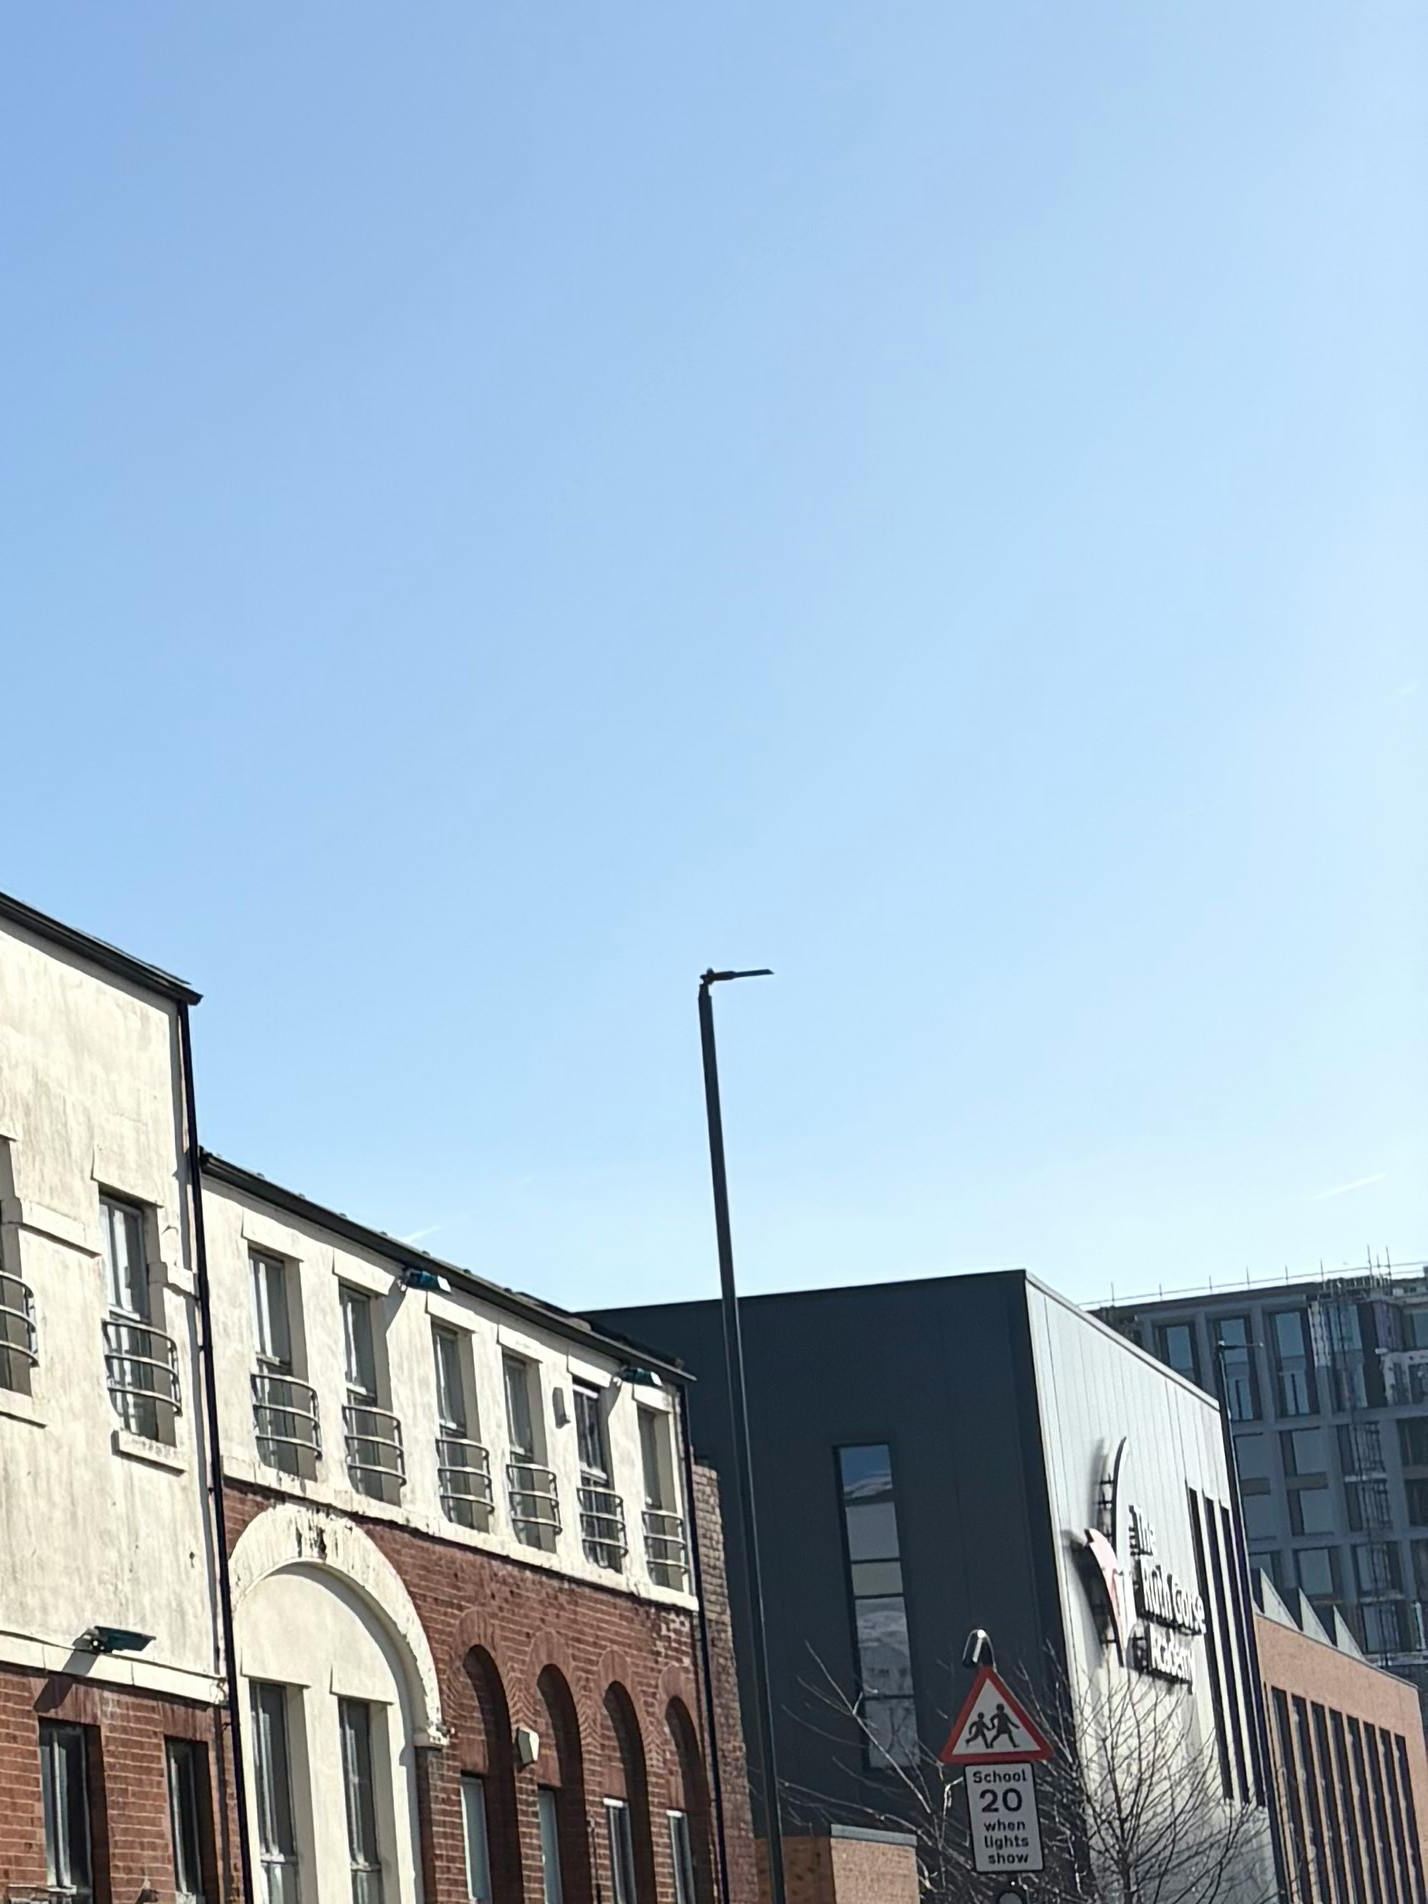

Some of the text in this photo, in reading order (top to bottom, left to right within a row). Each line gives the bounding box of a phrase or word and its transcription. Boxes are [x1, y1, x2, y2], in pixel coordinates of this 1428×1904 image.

[973, 1769, 1027, 1783] School
[980, 1788, 1022, 1812] 20
[984, 1818, 1026, 1832] when
[984, 1835, 1030, 1850] lights
[988, 1852, 1029, 1865] show
